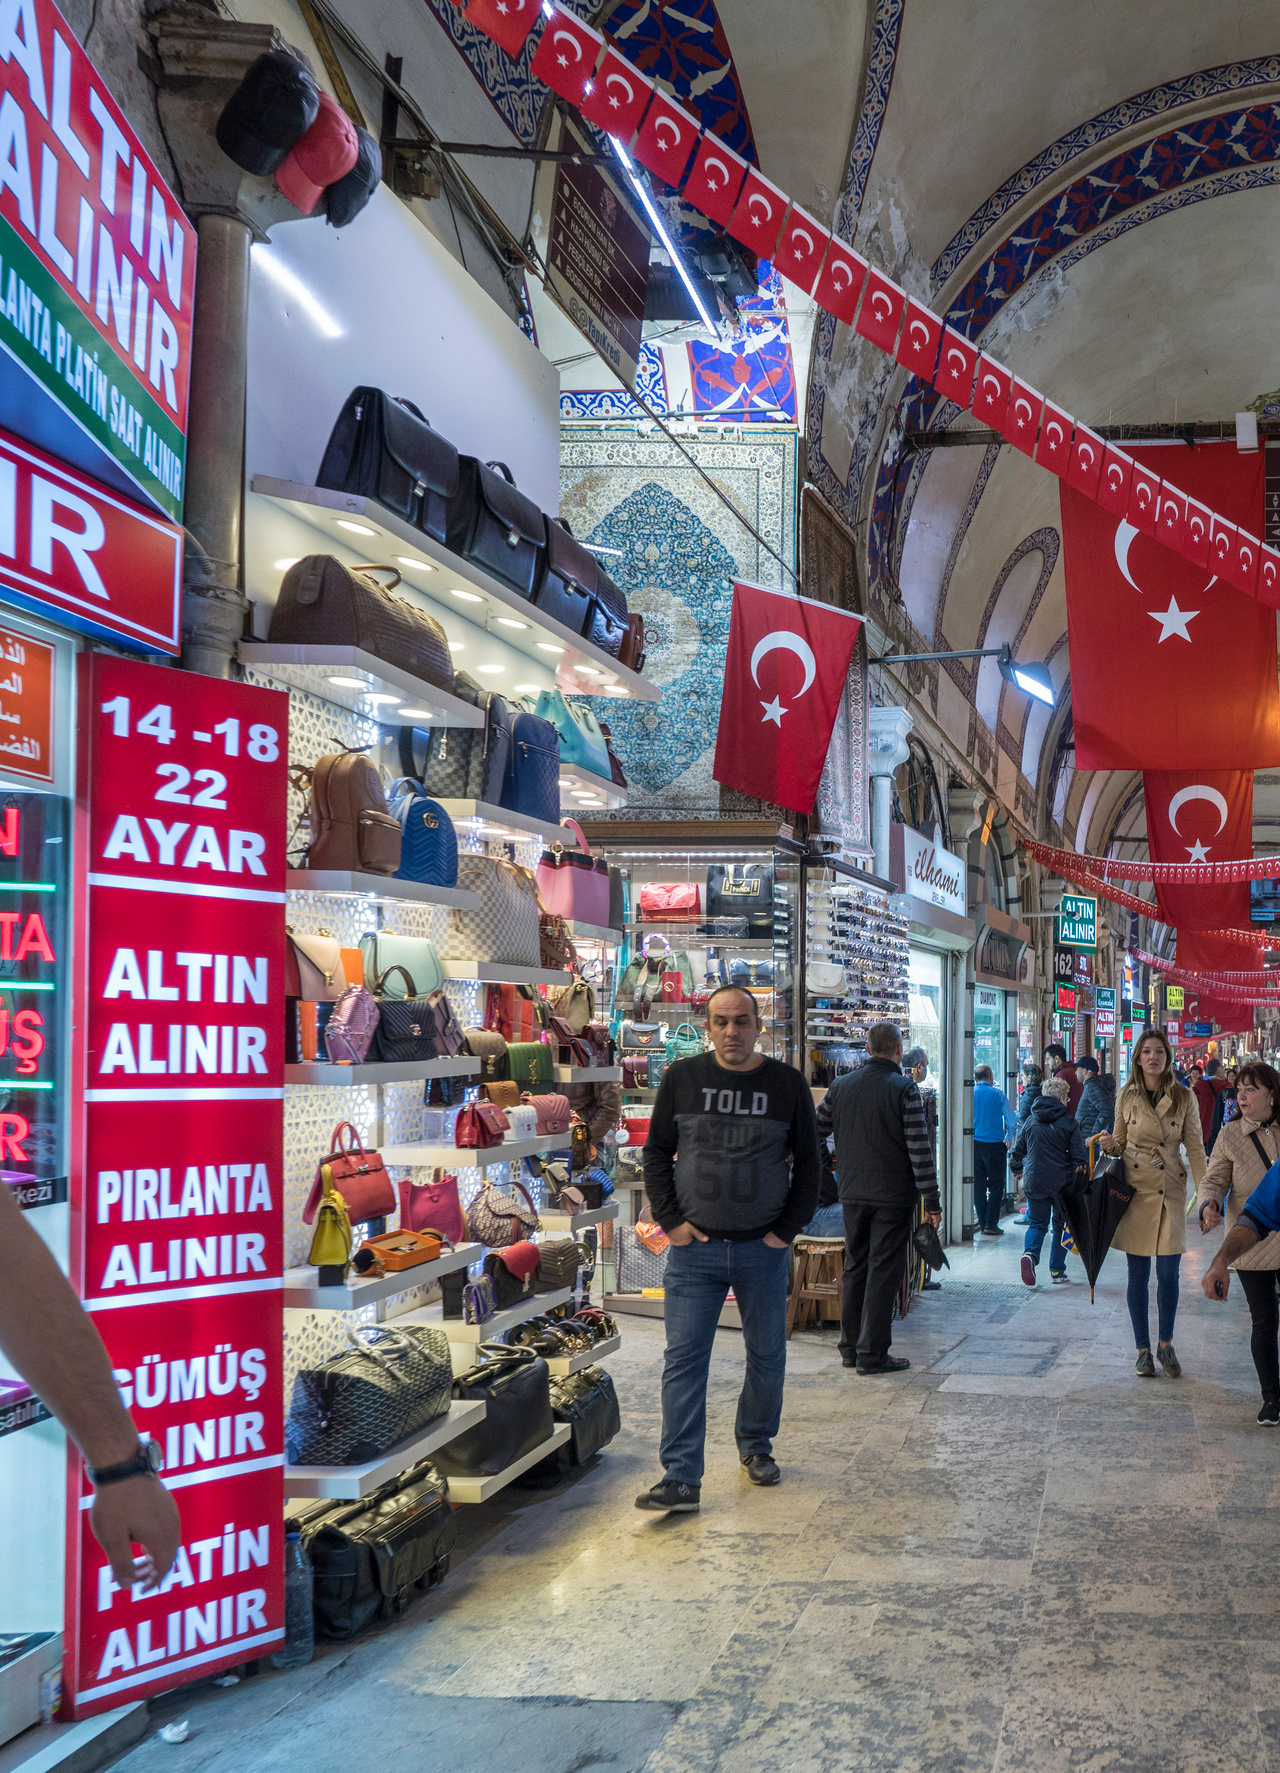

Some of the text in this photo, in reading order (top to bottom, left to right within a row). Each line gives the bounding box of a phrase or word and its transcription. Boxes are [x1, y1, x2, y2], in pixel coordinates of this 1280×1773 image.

[55, 320, 108, 422] PLATİN
[109, 384, 143, 458] SAAT
[143, 424, 182, 502] ALINIR
[101, 695, 176, 745] 14
[154, 763, 228, 810] 22
[103, 815, 267, 877] AYAR
[914, 847, 960, 898] ilhami
[1062, 922, 1095, 941] ALINIR
[1066, 900, 1093, 919] ALTIN
[103, 948, 268, 1005] ALTIN
[1055, 952, 1072, 975] 162
[1169, 988, 1184, 996] ALTIN
[1097, 1023, 1115, 1033] ALINIR
[1098, 1012, 1114, 1022] ALTIN
[100, 1023, 268, 1075] ALINIR
[701, 1087, 768, 1115] TOLD
[706, 1121, 754, 1148] YOU
[97, 1163, 273, 1224] PIRLANTA
[101, 1232, 267, 1290] ALINIR
[97, 1588, 269, 1680] ALINIR
